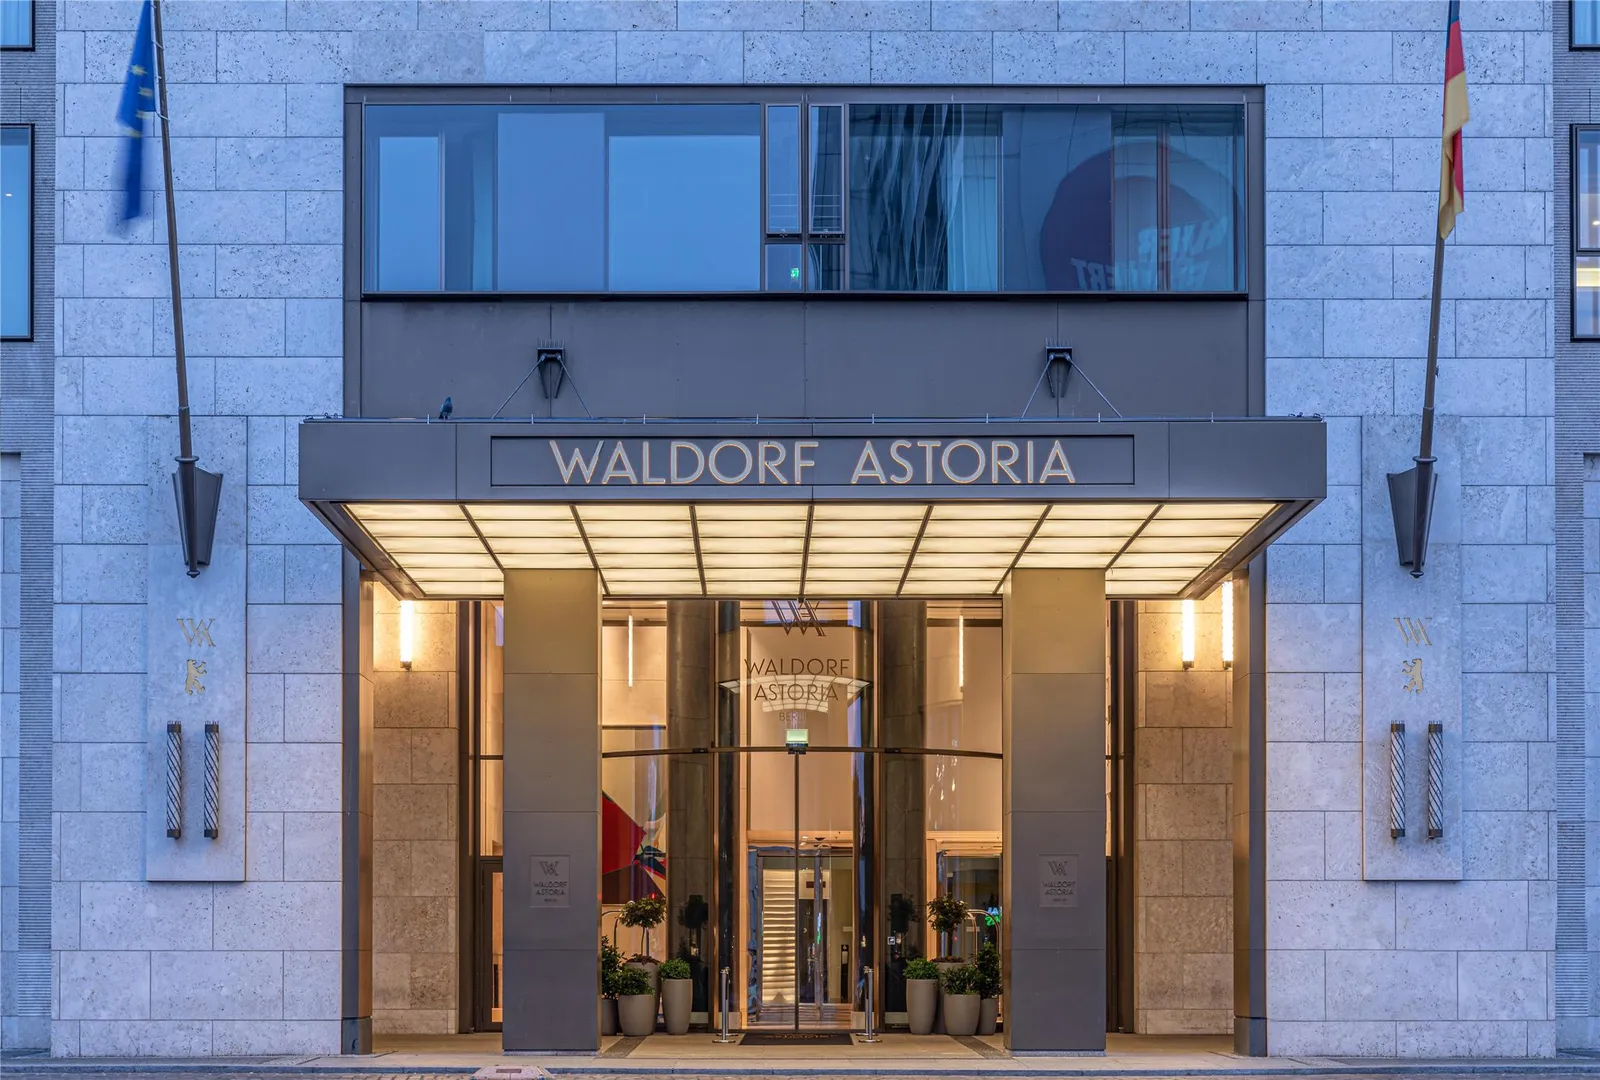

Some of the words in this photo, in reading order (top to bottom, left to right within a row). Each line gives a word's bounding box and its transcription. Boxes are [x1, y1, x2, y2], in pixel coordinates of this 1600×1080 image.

[549, 440, 818, 484] WALDORF
[851, 440, 1076, 484] ASTORIA
[744, 658, 850, 676] WALDORF
[753, 683, 839, 701] ASTORIA
